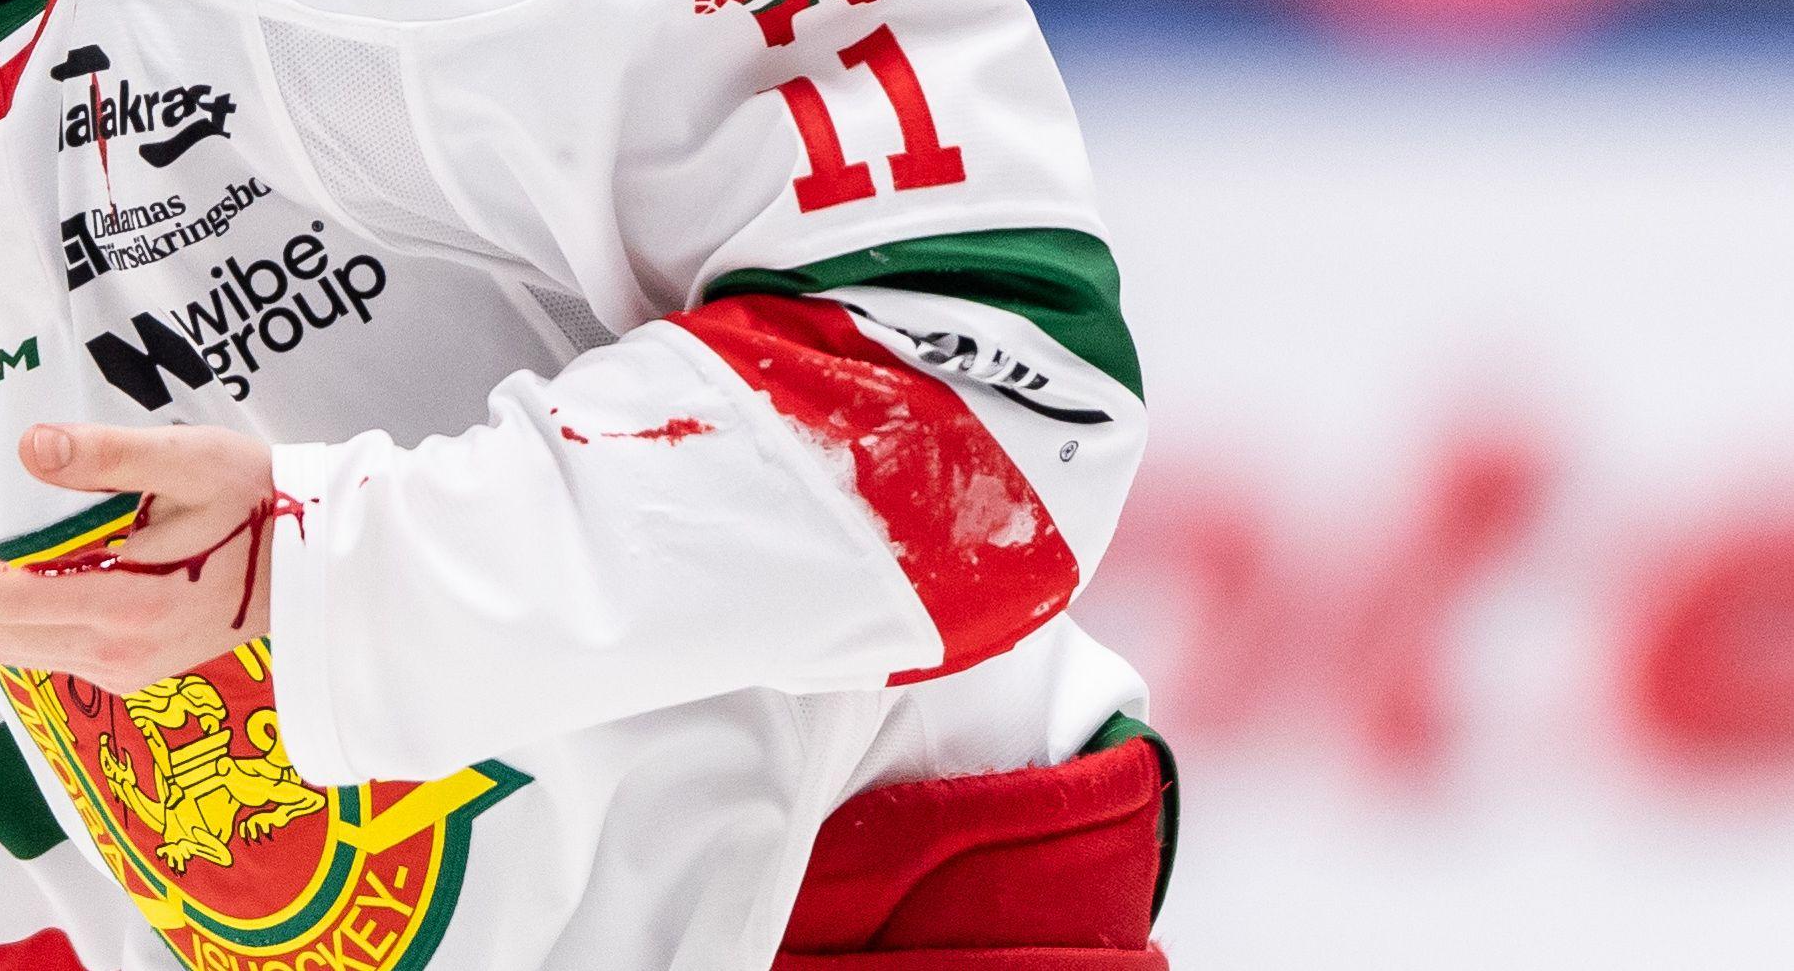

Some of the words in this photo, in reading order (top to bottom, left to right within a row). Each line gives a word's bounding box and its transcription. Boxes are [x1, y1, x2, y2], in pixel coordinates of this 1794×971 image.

[757, 22, 966, 214] 11
[91, 194, 187, 239] Dalarnas
[169, 234, 329, 346] wibe
[201, 253, 387, 403] group
